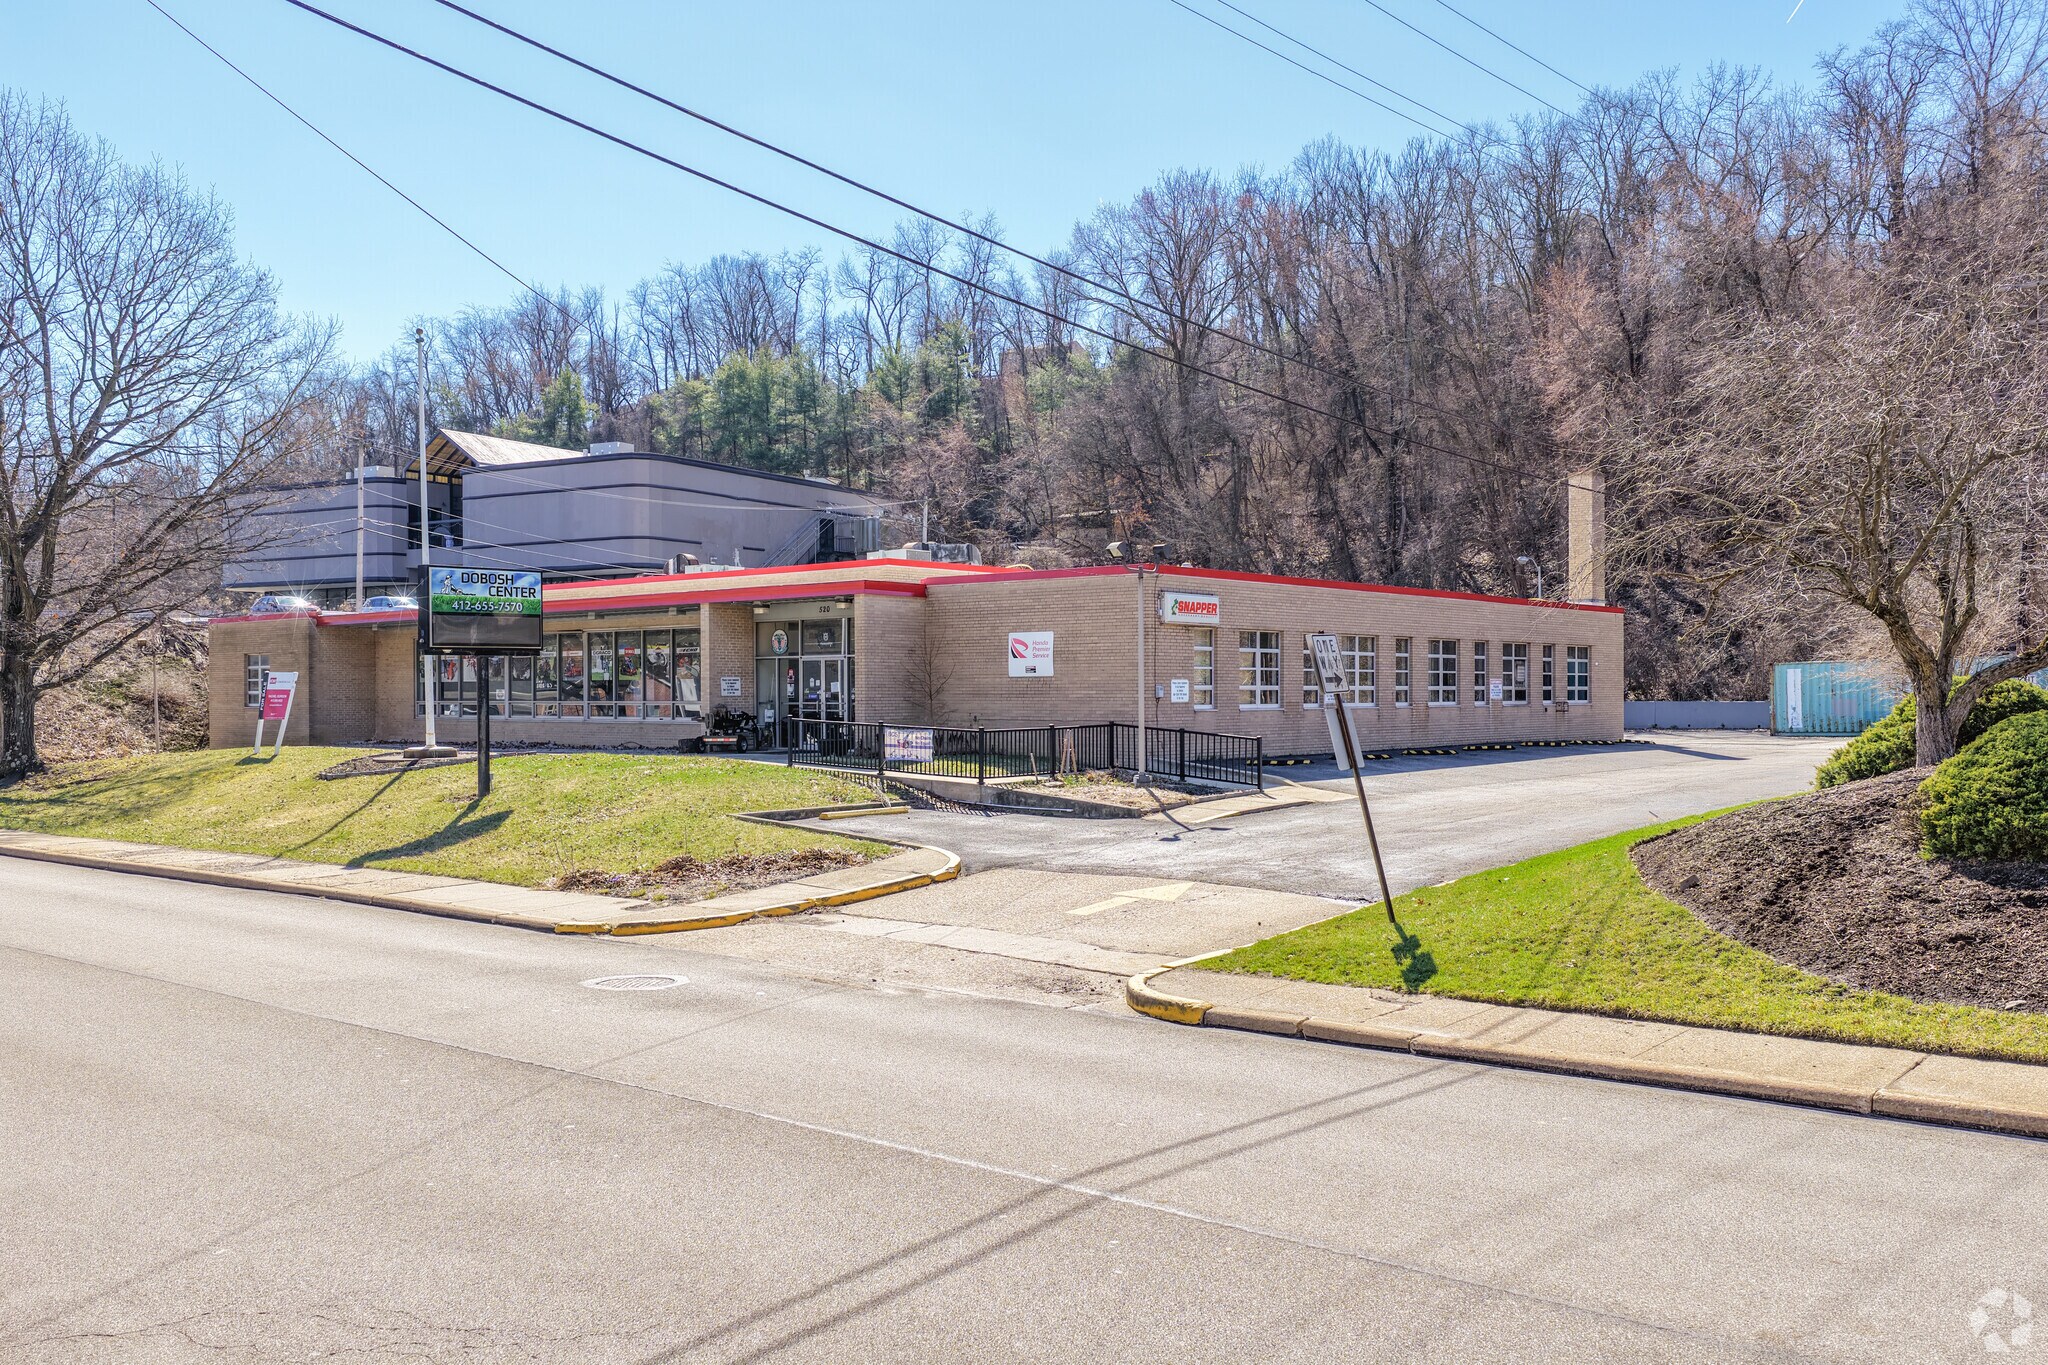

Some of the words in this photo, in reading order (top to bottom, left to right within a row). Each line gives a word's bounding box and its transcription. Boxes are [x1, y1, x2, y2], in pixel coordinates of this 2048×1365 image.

[461, 572, 514, 585] DOBOSH
[488, 586, 536, 598] CENTER
[452, 600, 523, 612] 412-655-7570
[819, 605, 831, 613] 520
[1177, 600, 1218, 614] SNAPPER
[1316, 639, 1336, 653] ONE
[1319, 655, 1339, 672] WAY
